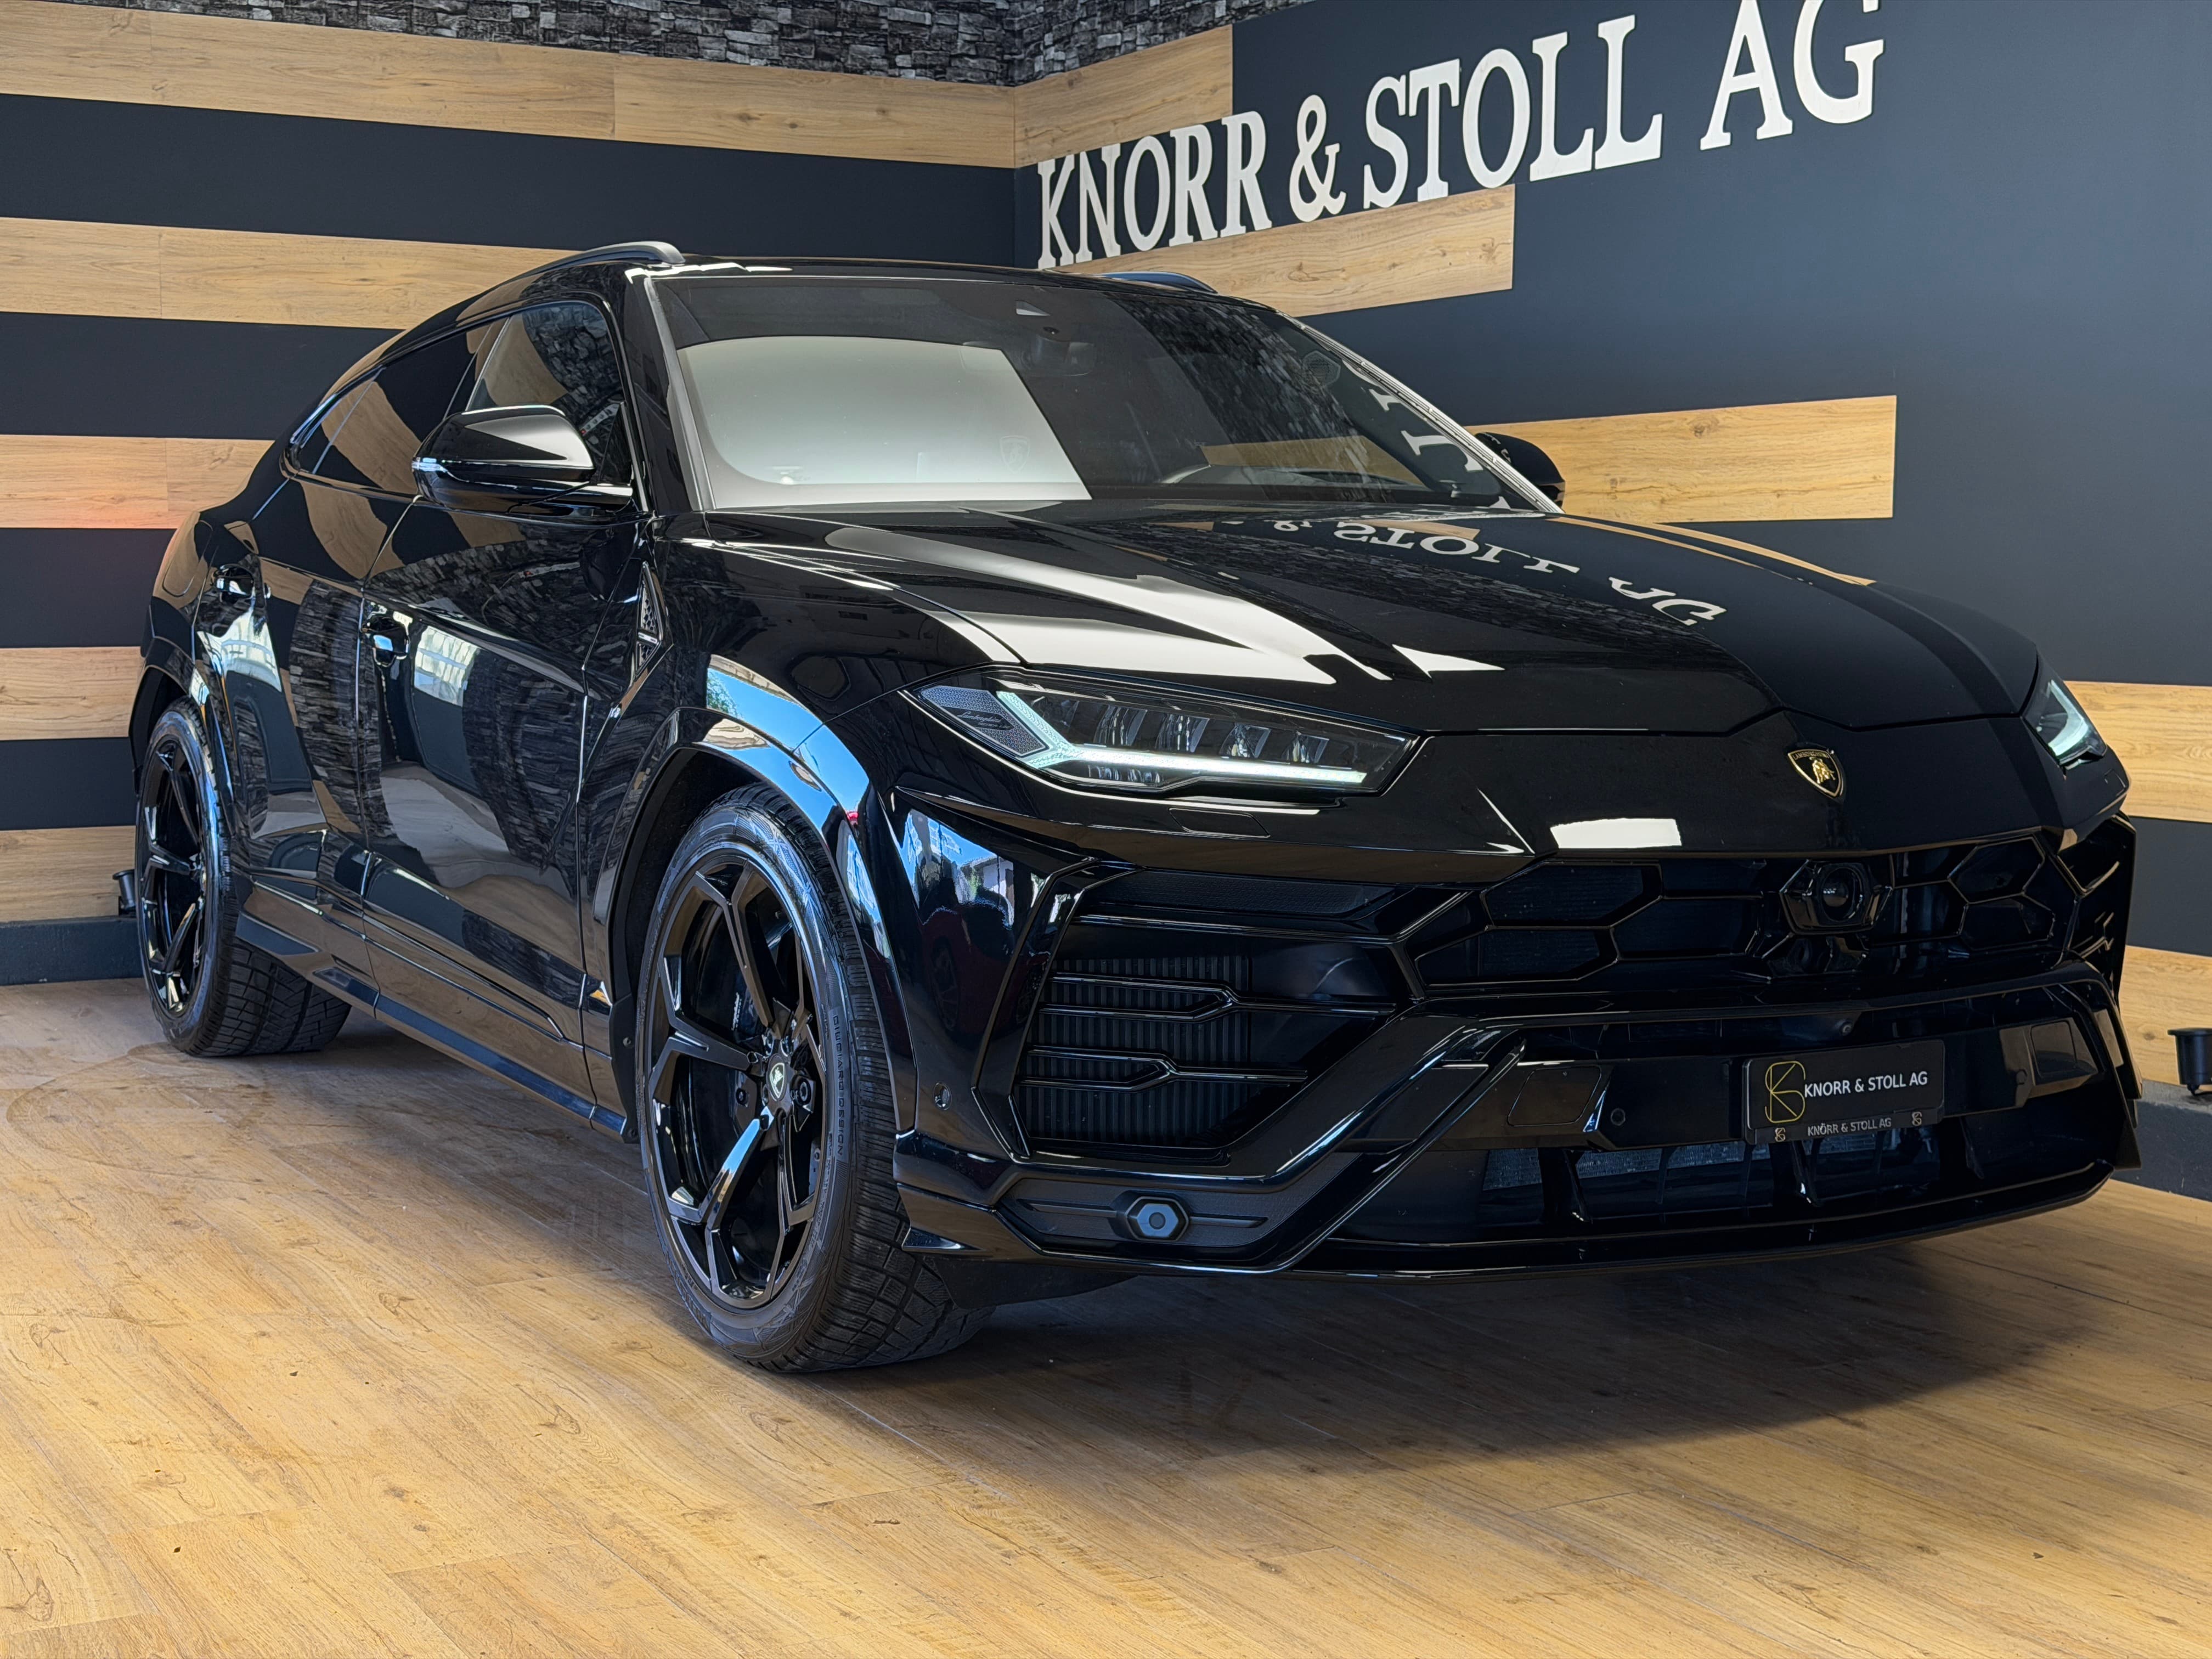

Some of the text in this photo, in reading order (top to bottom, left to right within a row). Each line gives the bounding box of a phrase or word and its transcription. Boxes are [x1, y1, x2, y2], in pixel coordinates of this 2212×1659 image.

[1038, 0, 1884, 270] KNORR & STOLL AG
[1804, 1071, 1928, 1098] KNORR & STOLL AG
[1841, 1123, 1848, 1133] &
[1850, 1119, 1878, 1132] STOLL
[1879, 1118, 1892, 1128] AG
